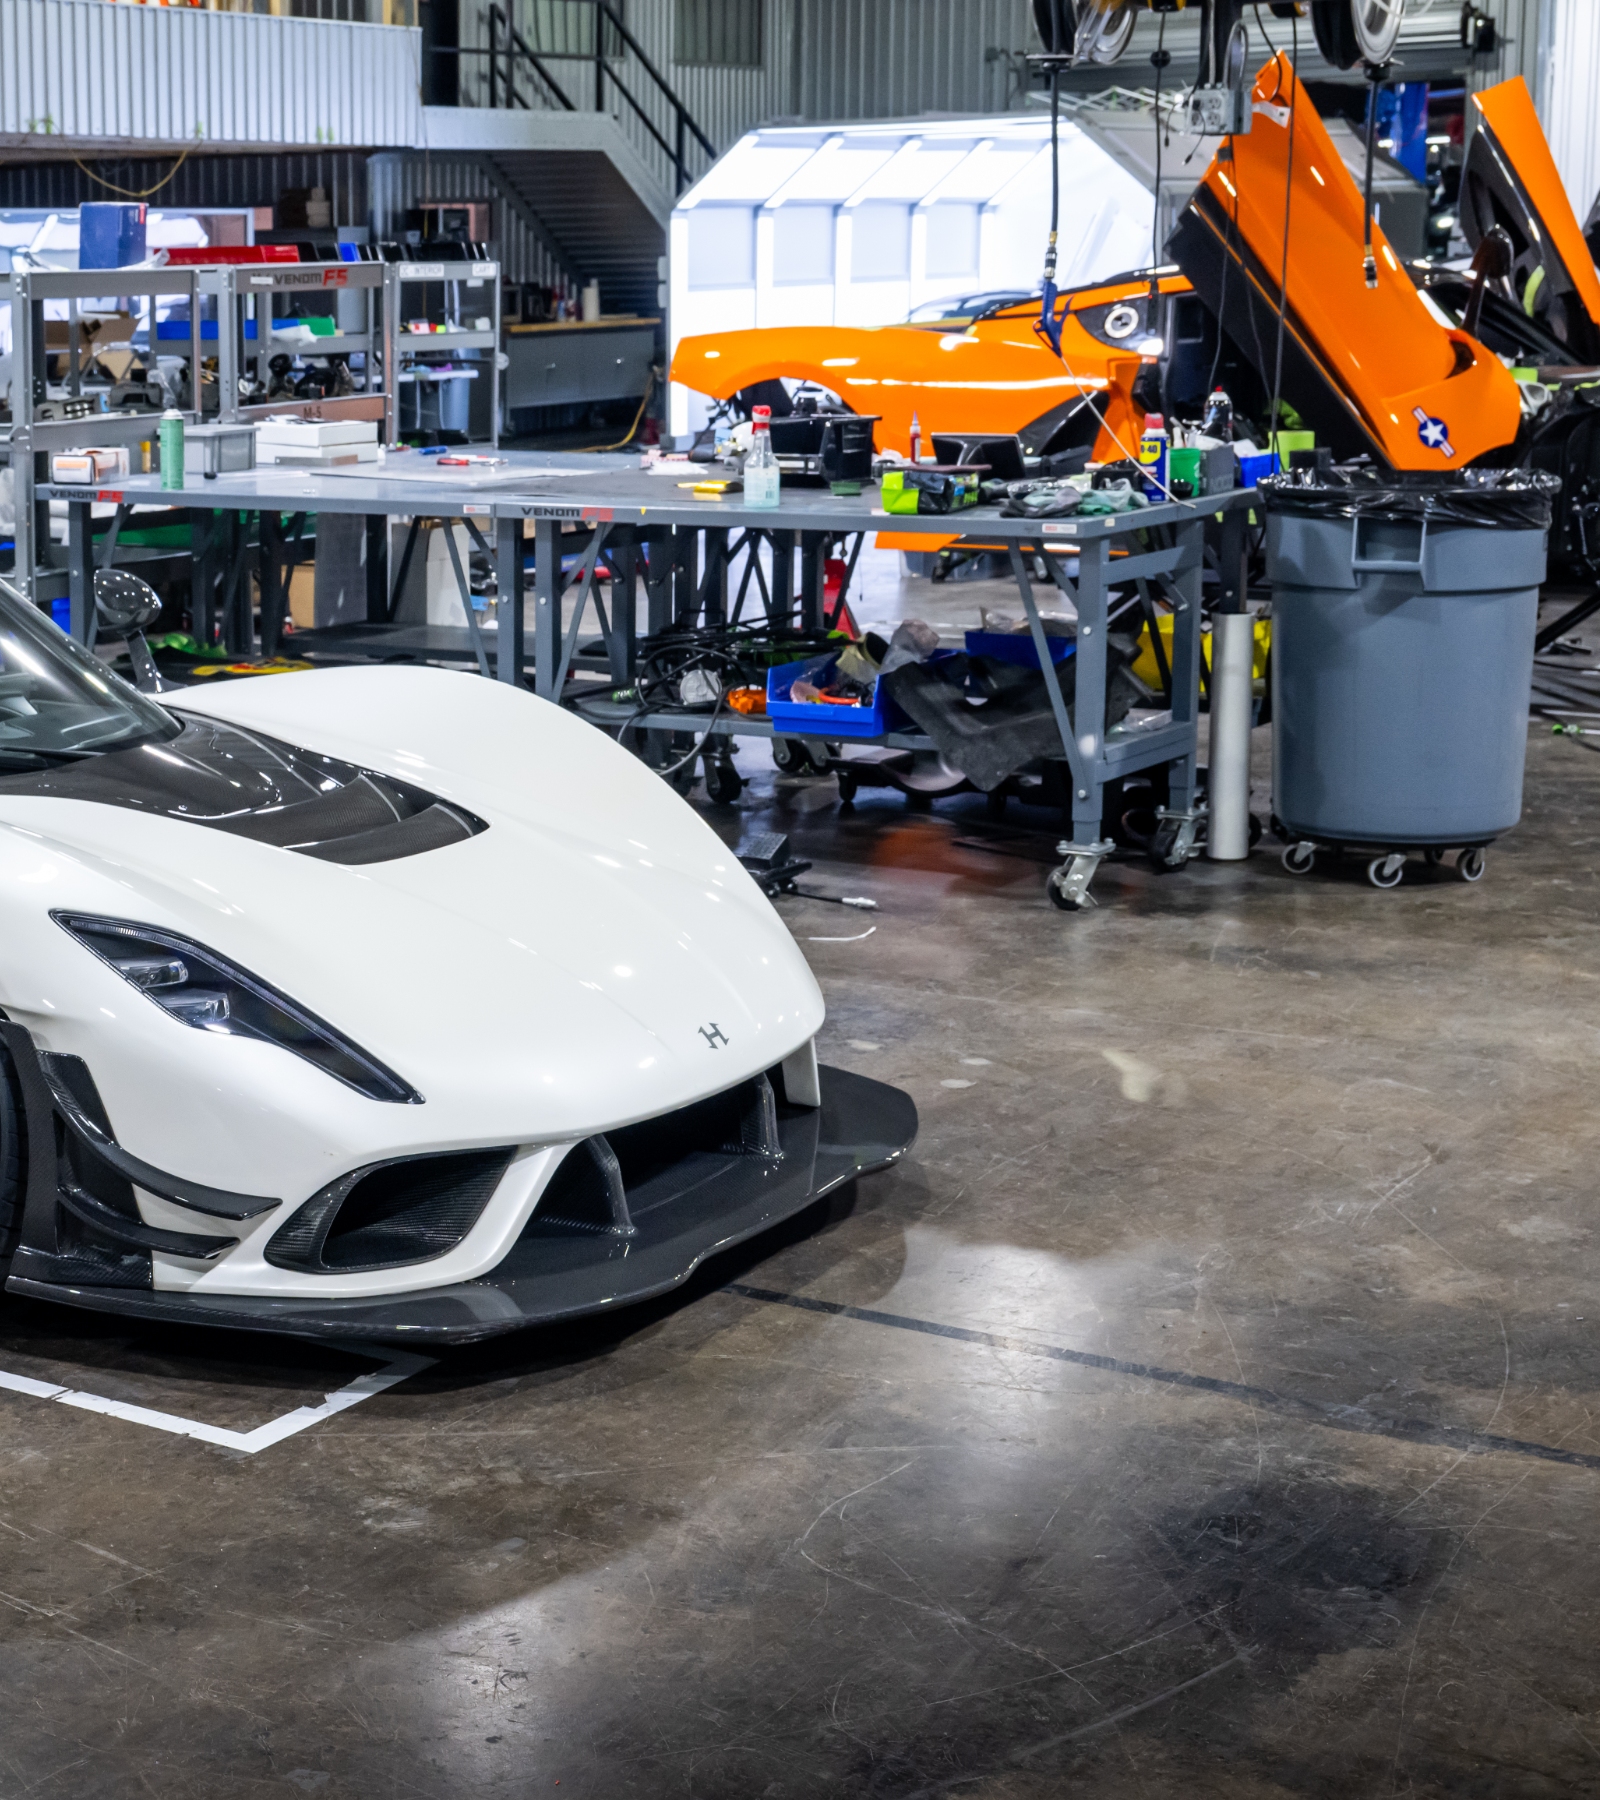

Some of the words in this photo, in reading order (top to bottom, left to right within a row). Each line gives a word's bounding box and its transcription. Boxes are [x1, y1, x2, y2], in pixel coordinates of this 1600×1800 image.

[274, 273, 321, 285] VENOM
[322, 268, 349, 287] F5
[49, 489, 97, 499] VENOM
[521, 507, 580, 518] VENOM
[698, 1022, 730, 1050] H
